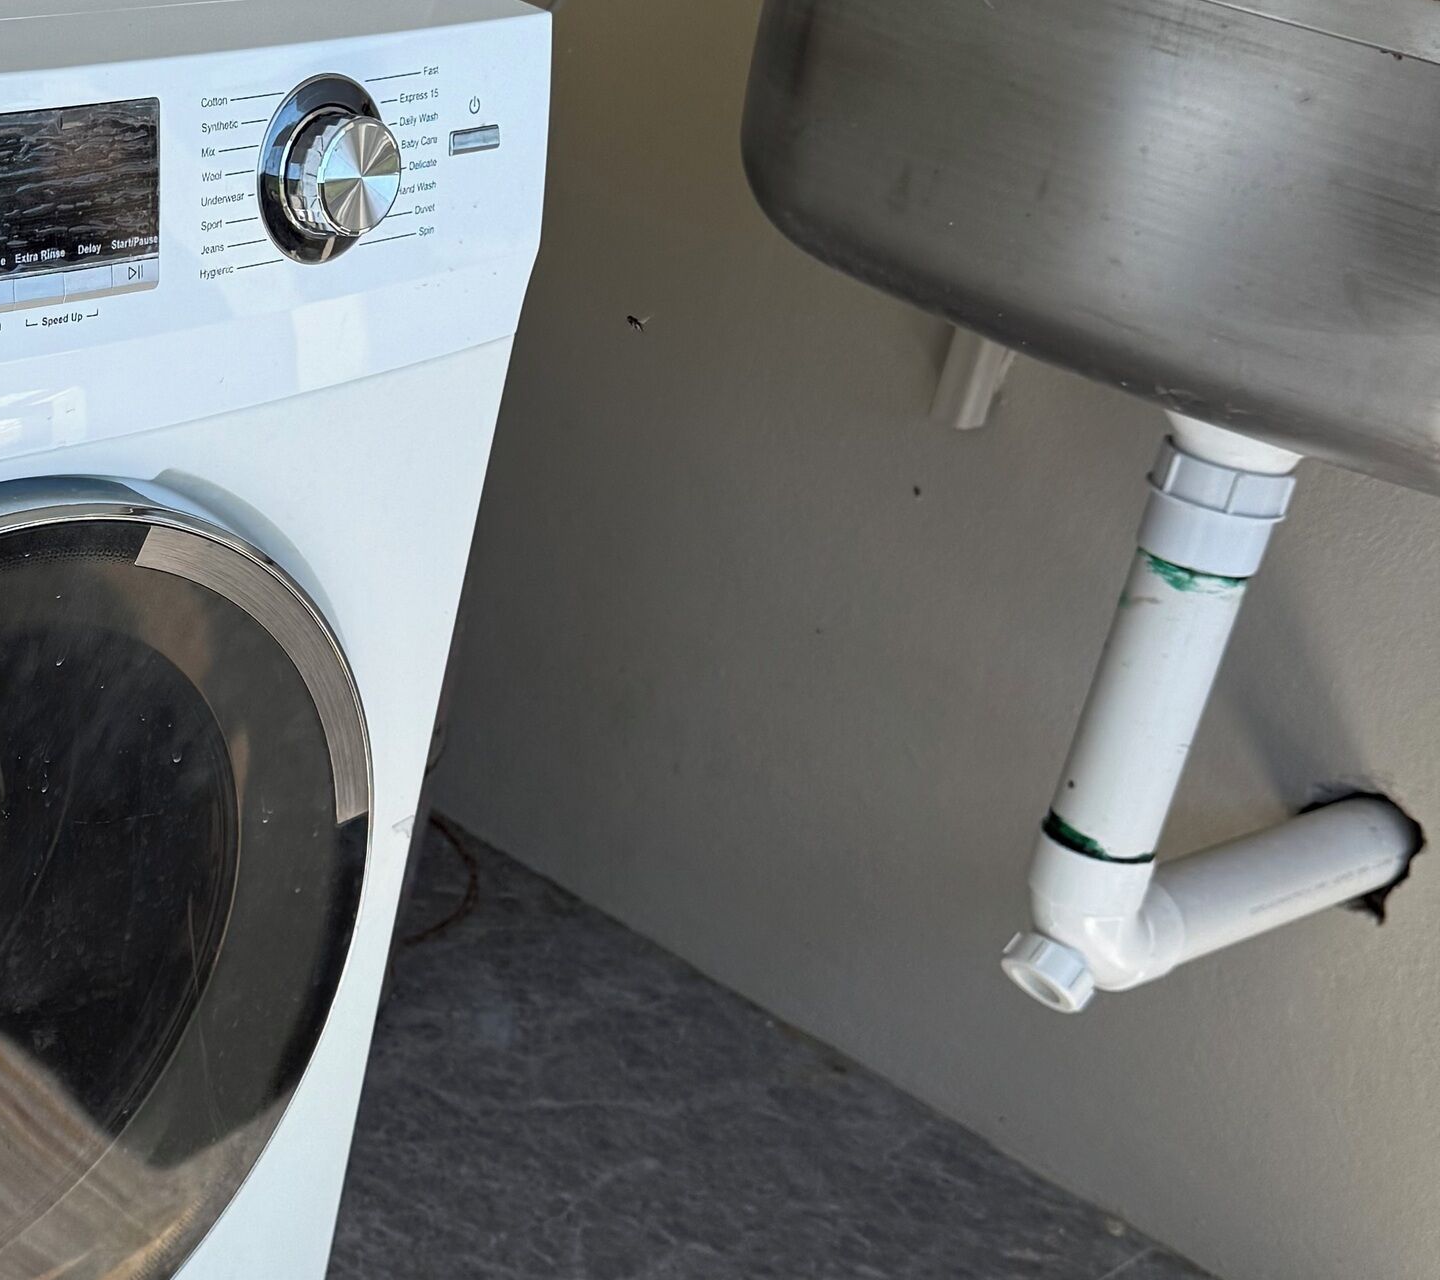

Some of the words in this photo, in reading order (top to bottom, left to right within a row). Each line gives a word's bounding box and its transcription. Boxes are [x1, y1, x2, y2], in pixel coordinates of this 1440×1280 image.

[423, 66, 439, 75] Fast
[399, 93, 428, 103] Express
[430, 88, 439, 98] 15
[201, 97, 228, 108] Cotton
[399, 117, 417, 127] Daily
[419, 112, 439, 122] Wash
[201, 120, 238, 134] Synthetic
[401, 140, 419, 150] Baby
[420, 136, 438, 146] Care
[201, 148, 216, 157] Mix
[409, 159, 438, 170] Delicate
[201, 171, 222, 182] Wool
[417, 181, 437, 191] Wash
[201, 193, 245, 207] Underwear
[414, 204, 436, 214] Duvet
[201, 219, 223, 232] Sport
[418, 227, 435, 237] Spin
[111, 235, 159, 250] Start/Pause
[77, 243, 102, 255] Delay
[201, 245, 225, 255] Jeans
[15, 252, 38, 264] Extra
[40, 247, 66, 262] Rinse
[42, 317, 69, 328] Speed
[71, 312, 83, 324] Up
